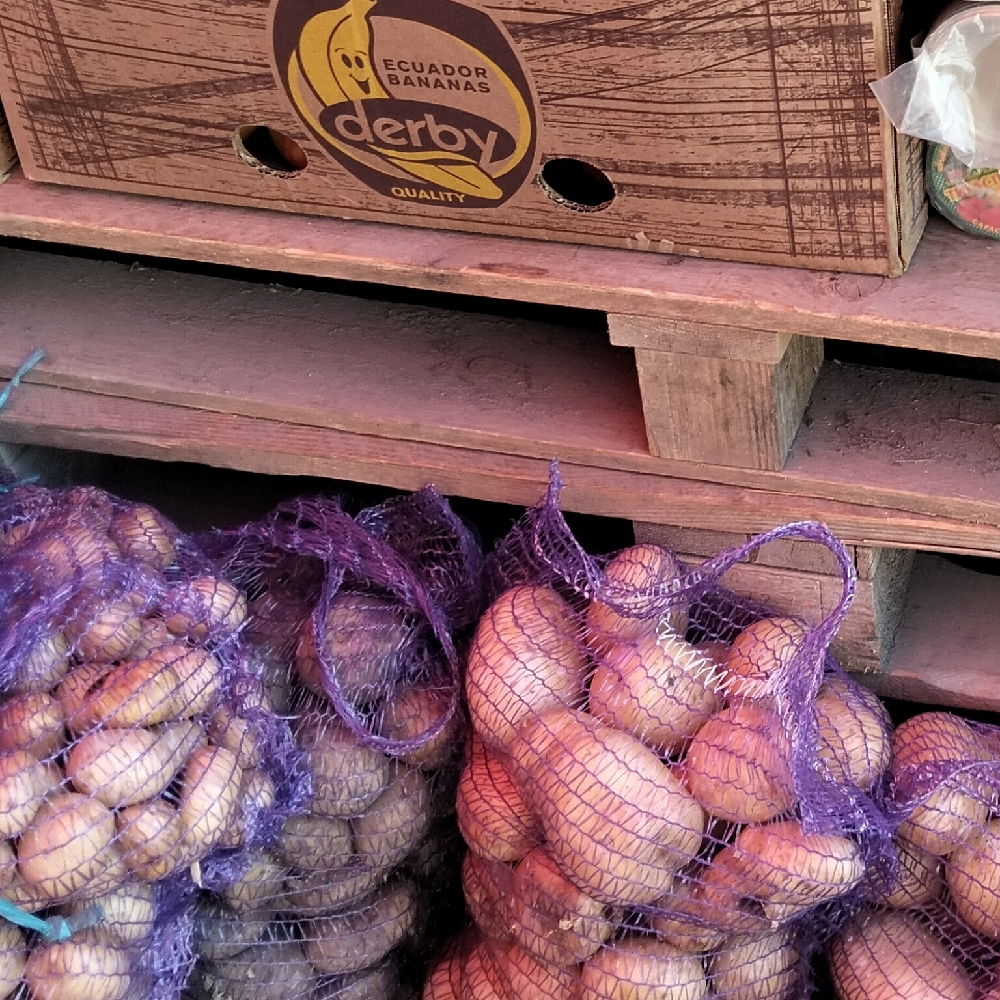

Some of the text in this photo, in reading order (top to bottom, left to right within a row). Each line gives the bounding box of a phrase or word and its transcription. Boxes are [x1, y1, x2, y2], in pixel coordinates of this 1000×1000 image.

[382, 58, 488, 79] ECUADOR
[388, 73, 491, 94] BANANAS
[333, 100, 498, 167] derby
[391, 186, 466, 204] QUALITY
